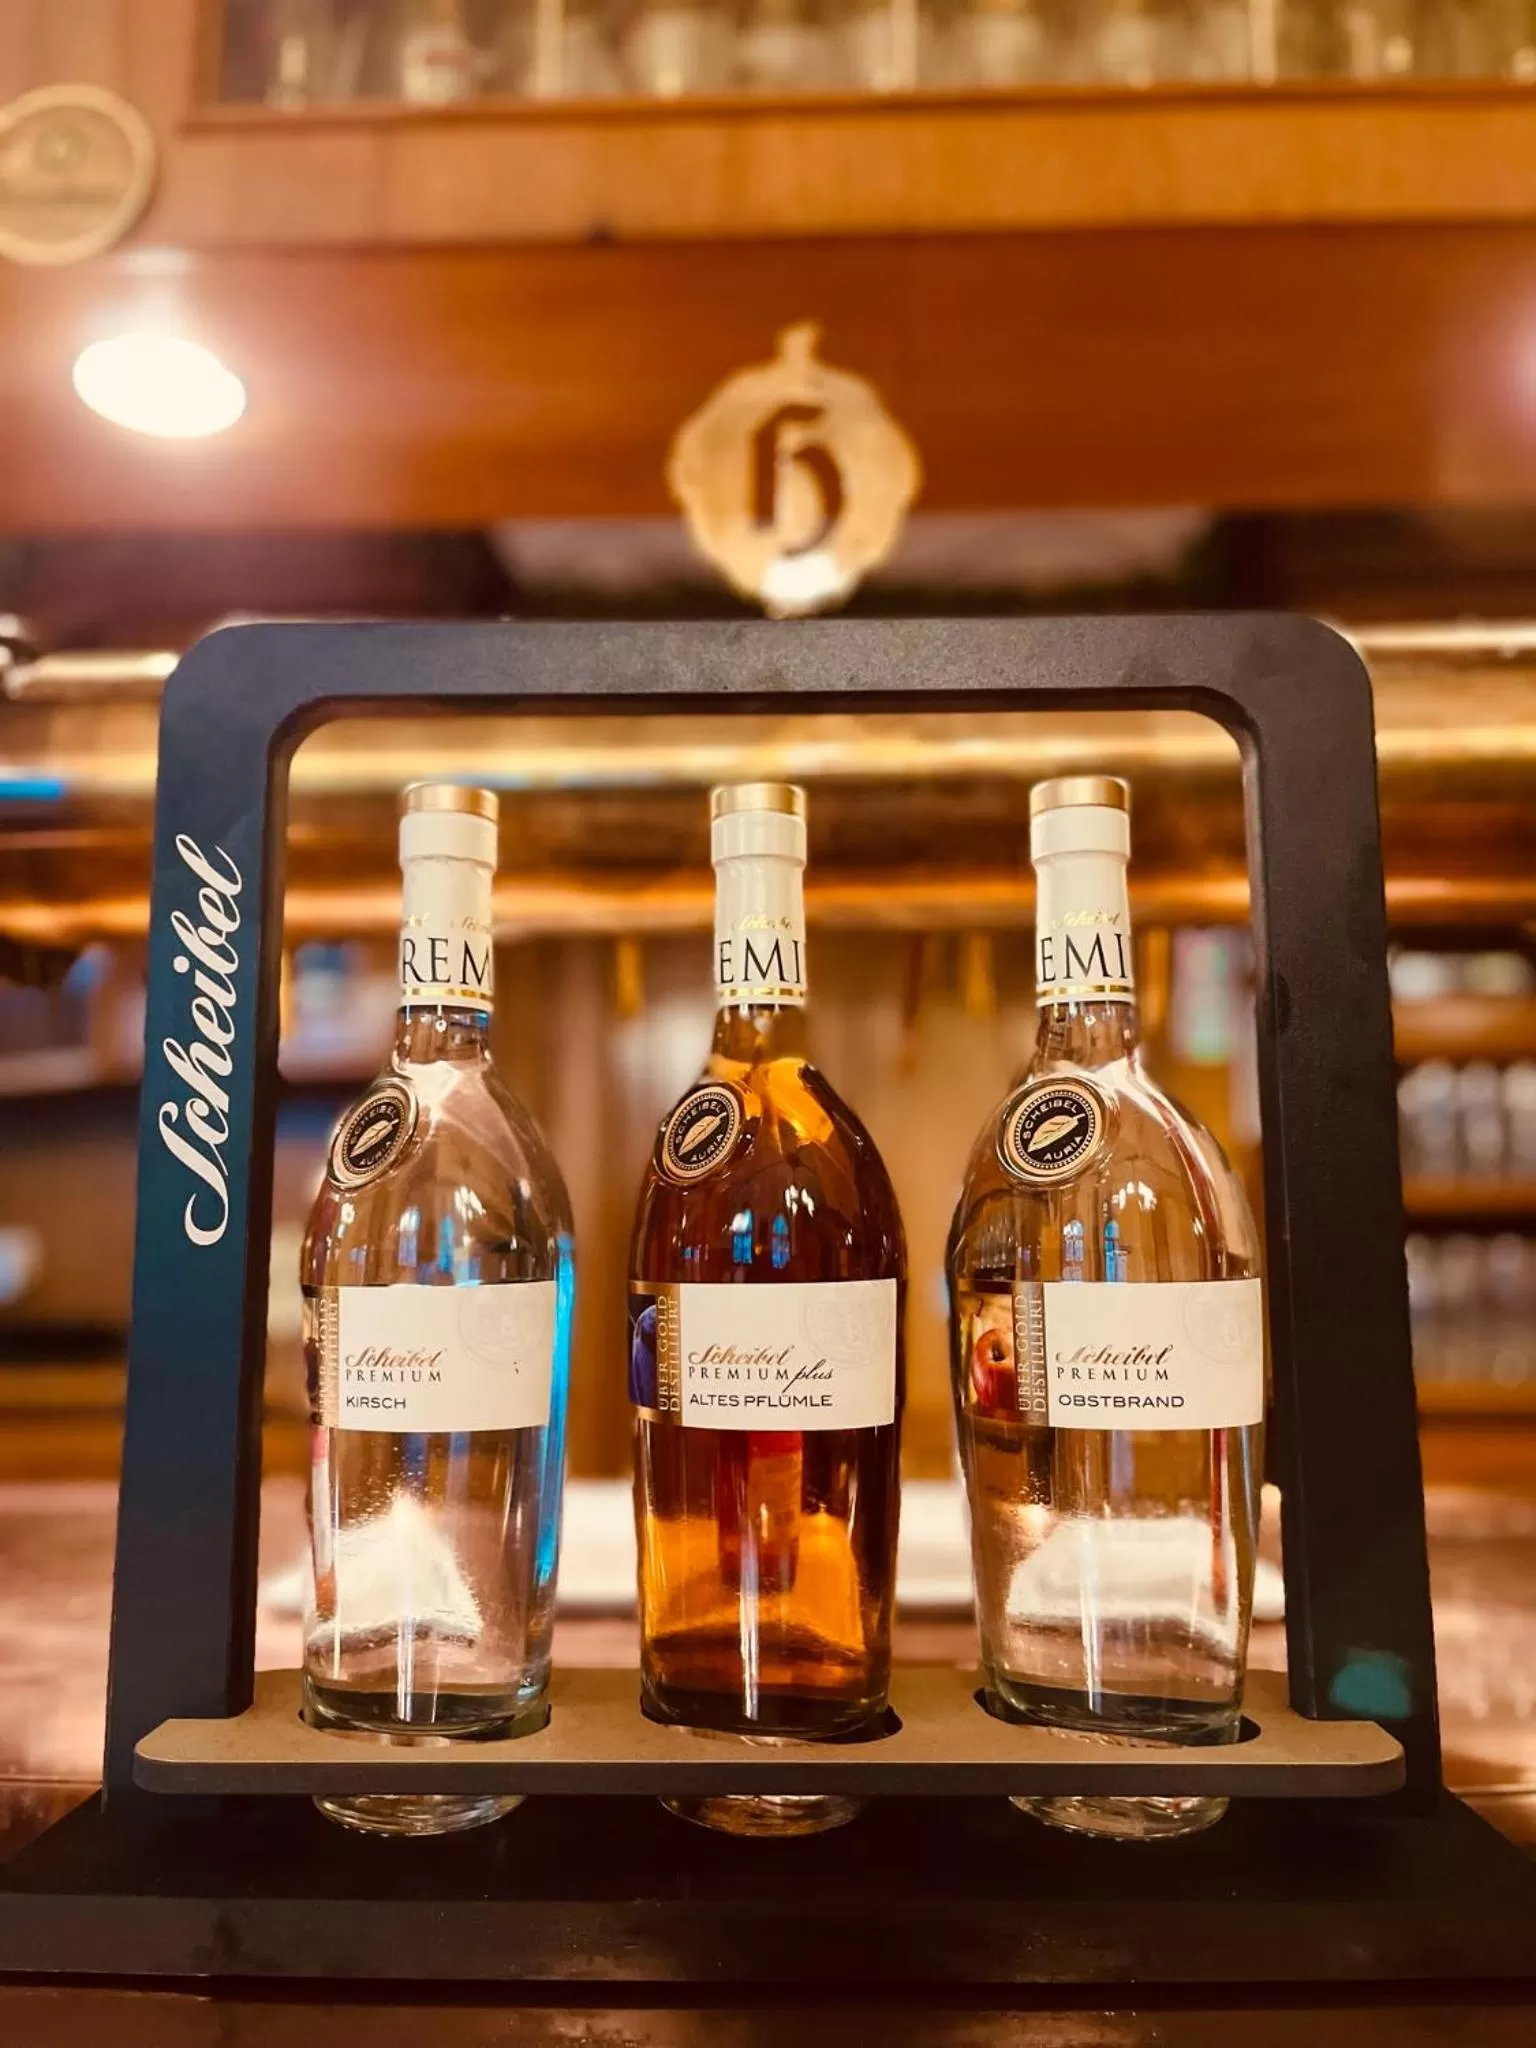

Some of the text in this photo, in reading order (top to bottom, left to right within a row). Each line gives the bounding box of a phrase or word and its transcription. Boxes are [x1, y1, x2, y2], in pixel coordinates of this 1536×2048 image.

[158, 832, 243, 1247] Scheibel
[1022, 1098, 1079, 1141] SCHEIBEL
[1037, 1134, 1084, 1161] AURIA
[657, 1295, 669, 1353] GOLD
[1014, 1295, 1029, 1352] GOLD
[344, 1346, 447, 1368] Scheibel
[687, 1344, 795, 1366] Scheibel
[1055, 1344, 1173, 1366] Scheibel
[345, 1368, 443, 1382] PREMIUM
[688, 1358, 834, 1394] PREMIUM plus
[1057, 1366, 1169, 1381] PREMIUM
[345, 1395, 407, 1409] KIRSCH
[689, 1392, 834, 1408] ALTES PFLÜMLE
[1058, 1394, 1185, 1409] OBSTBRAND
